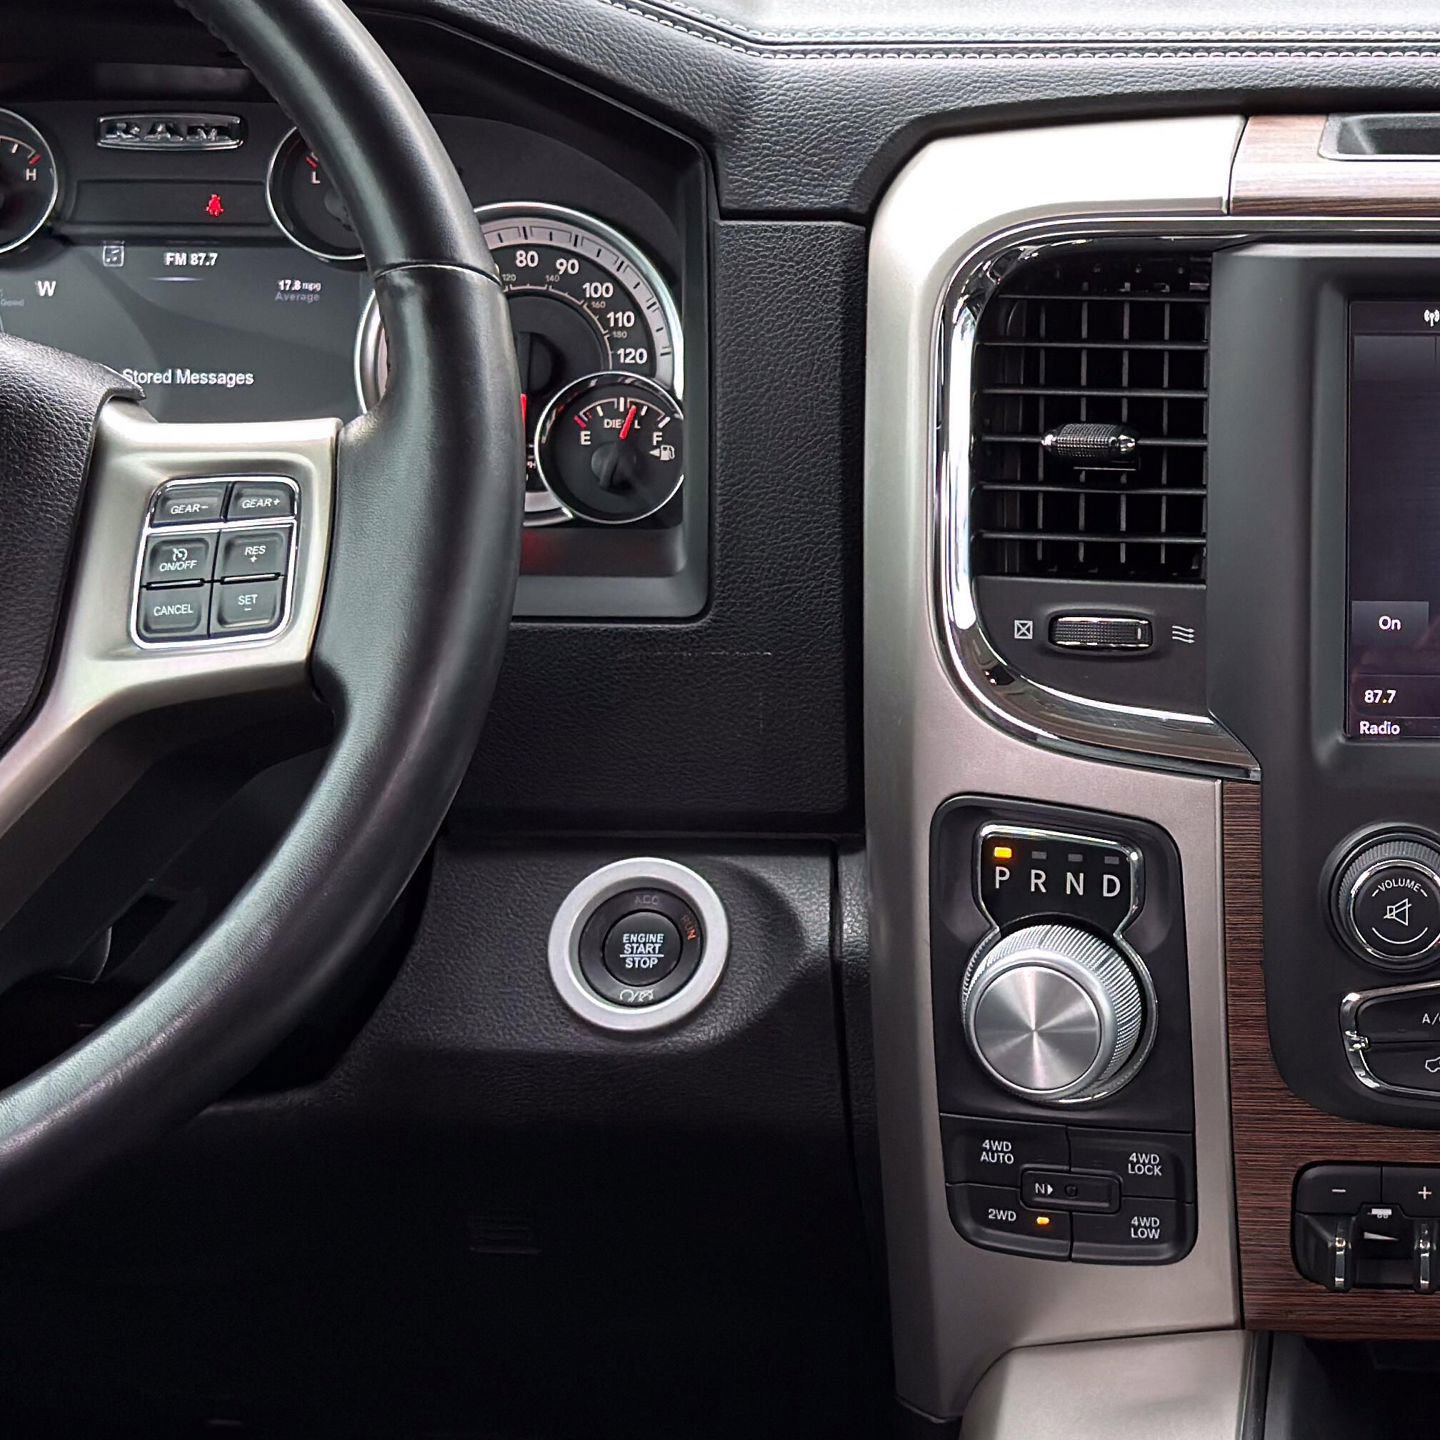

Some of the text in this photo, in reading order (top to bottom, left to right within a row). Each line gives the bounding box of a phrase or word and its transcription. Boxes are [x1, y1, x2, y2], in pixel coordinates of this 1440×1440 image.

[26, 167, 38, 182] H
[165, 253, 218, 266] FM 87.7
[515, 250, 539, 267] 80
[555, 258, 579, 275] 90
[36, 280, 57, 297] W
[277, 279, 322, 292] 17.8 mpg
[582, 282, 613, 298] 100
[274, 292, 321, 303] Average
[606, 311, 635, 327] 110
[616, 348, 648, 364] 120
[122, 368, 254, 388] Stored Messages
[603, 419, 640, 429] DIEL
[580, 431, 591, 445] E
[652, 432, 663, 446] F
[244, 546, 266, 556] RES
[159, 560, 197, 572] ON/OFF
[238, 594, 258, 606] SET
[153, 604, 194, 616] CANCEL
[1378, 615, 1401, 631] On
[1364, 688, 1396, 706] 87.7
[1359, 721, 1400, 736] Radio
[994, 866, 1121, 898] P R N D
[1378, 878, 1422, 895] VOLUME
[622, 933, 665, 944] ENGINE
[623, 943, 662, 955] START
[625, 957, 659, 969] STOP
[982, 1139, 1012, 1152] 4WD
[980, 1151, 1015, 1165] AUTO
[1128, 1152, 1160, 1165] 4WD
[1127, 1163, 1162, 1177] LOCK
[988, 1209, 1017, 1223] 2WD
[1130, 1216, 1160, 1228] 4WD
[1130, 1226, 1160, 1240] LOW
